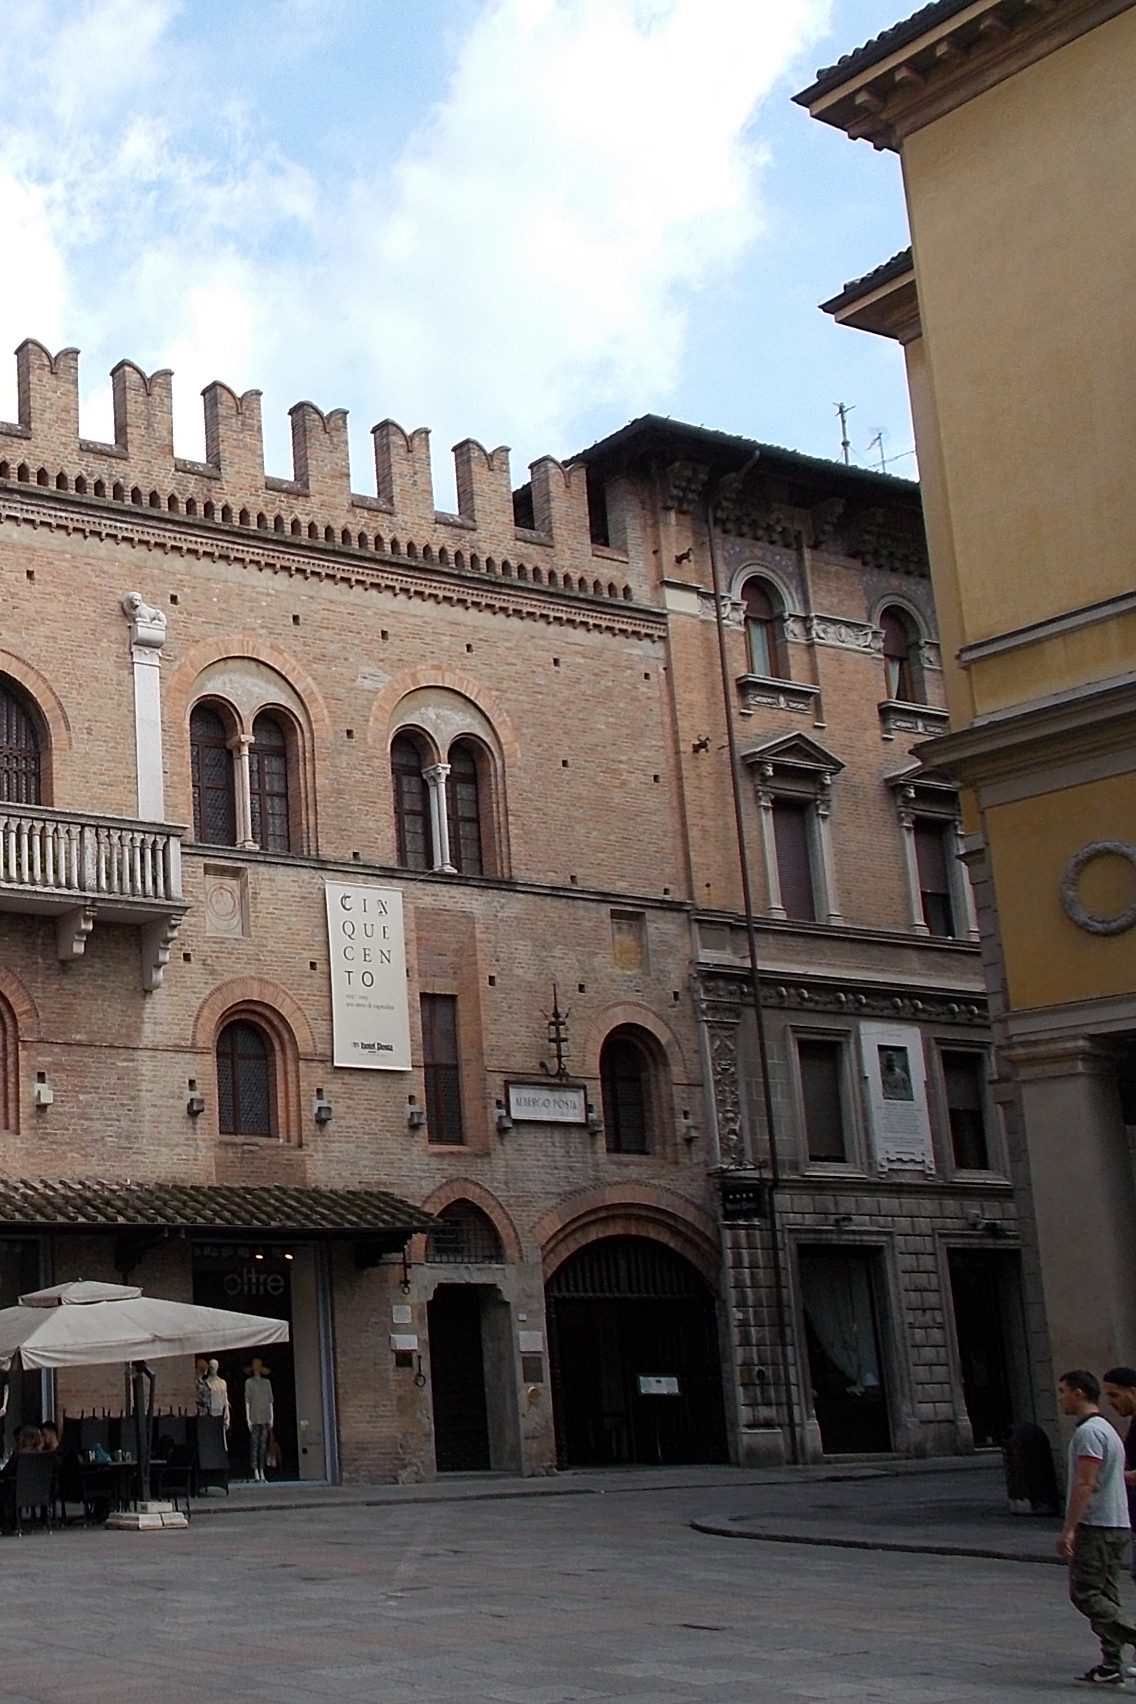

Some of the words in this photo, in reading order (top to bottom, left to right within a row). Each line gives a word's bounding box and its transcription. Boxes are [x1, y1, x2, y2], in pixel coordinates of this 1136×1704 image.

[515, 1096, 551, 1108] ALBERGO
[553, 1099, 577, 1110] POSTA
[224, 1266, 285, 1296] oltre
